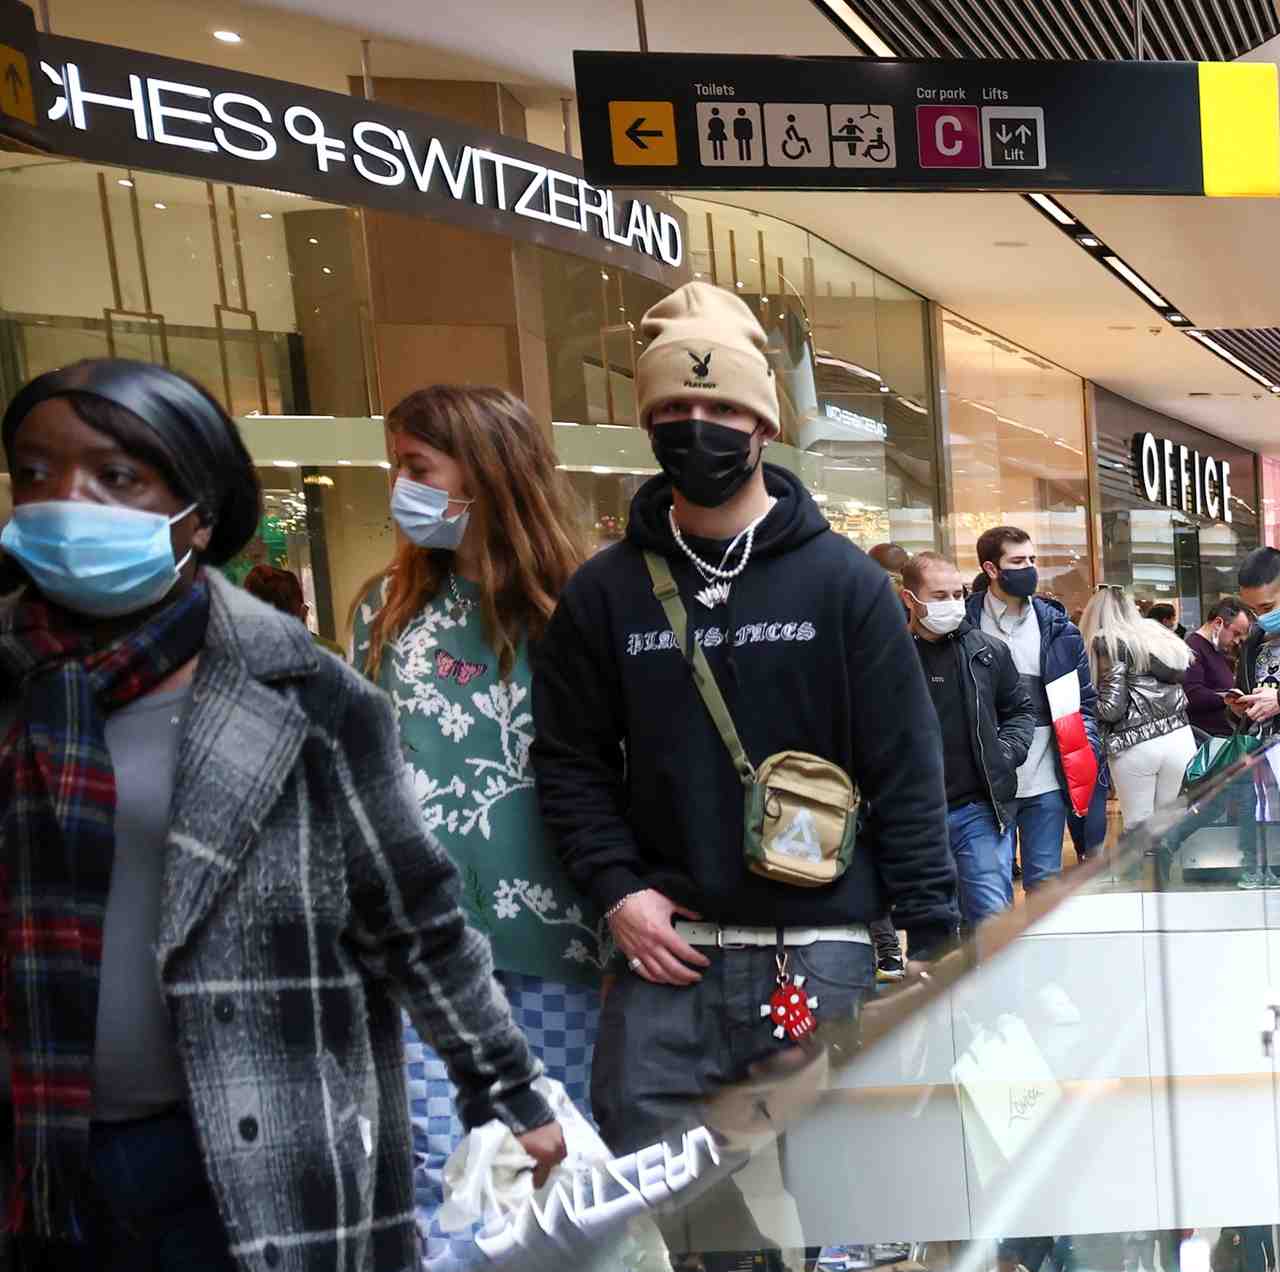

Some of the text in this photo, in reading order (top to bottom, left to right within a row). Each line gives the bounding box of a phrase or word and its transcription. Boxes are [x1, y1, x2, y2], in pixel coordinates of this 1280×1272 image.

[694, 83, 735, 97] Toilets
[916, 86, 1009, 103] Car park Lifts
[934, 116, 963, 157] C
[1003, 148, 1025, 162] Lift
[284, 106, 346, 172] OF
[352, 121, 683, 268] SWITZERLAND
[1142, 431, 1233, 524] OFFICE
